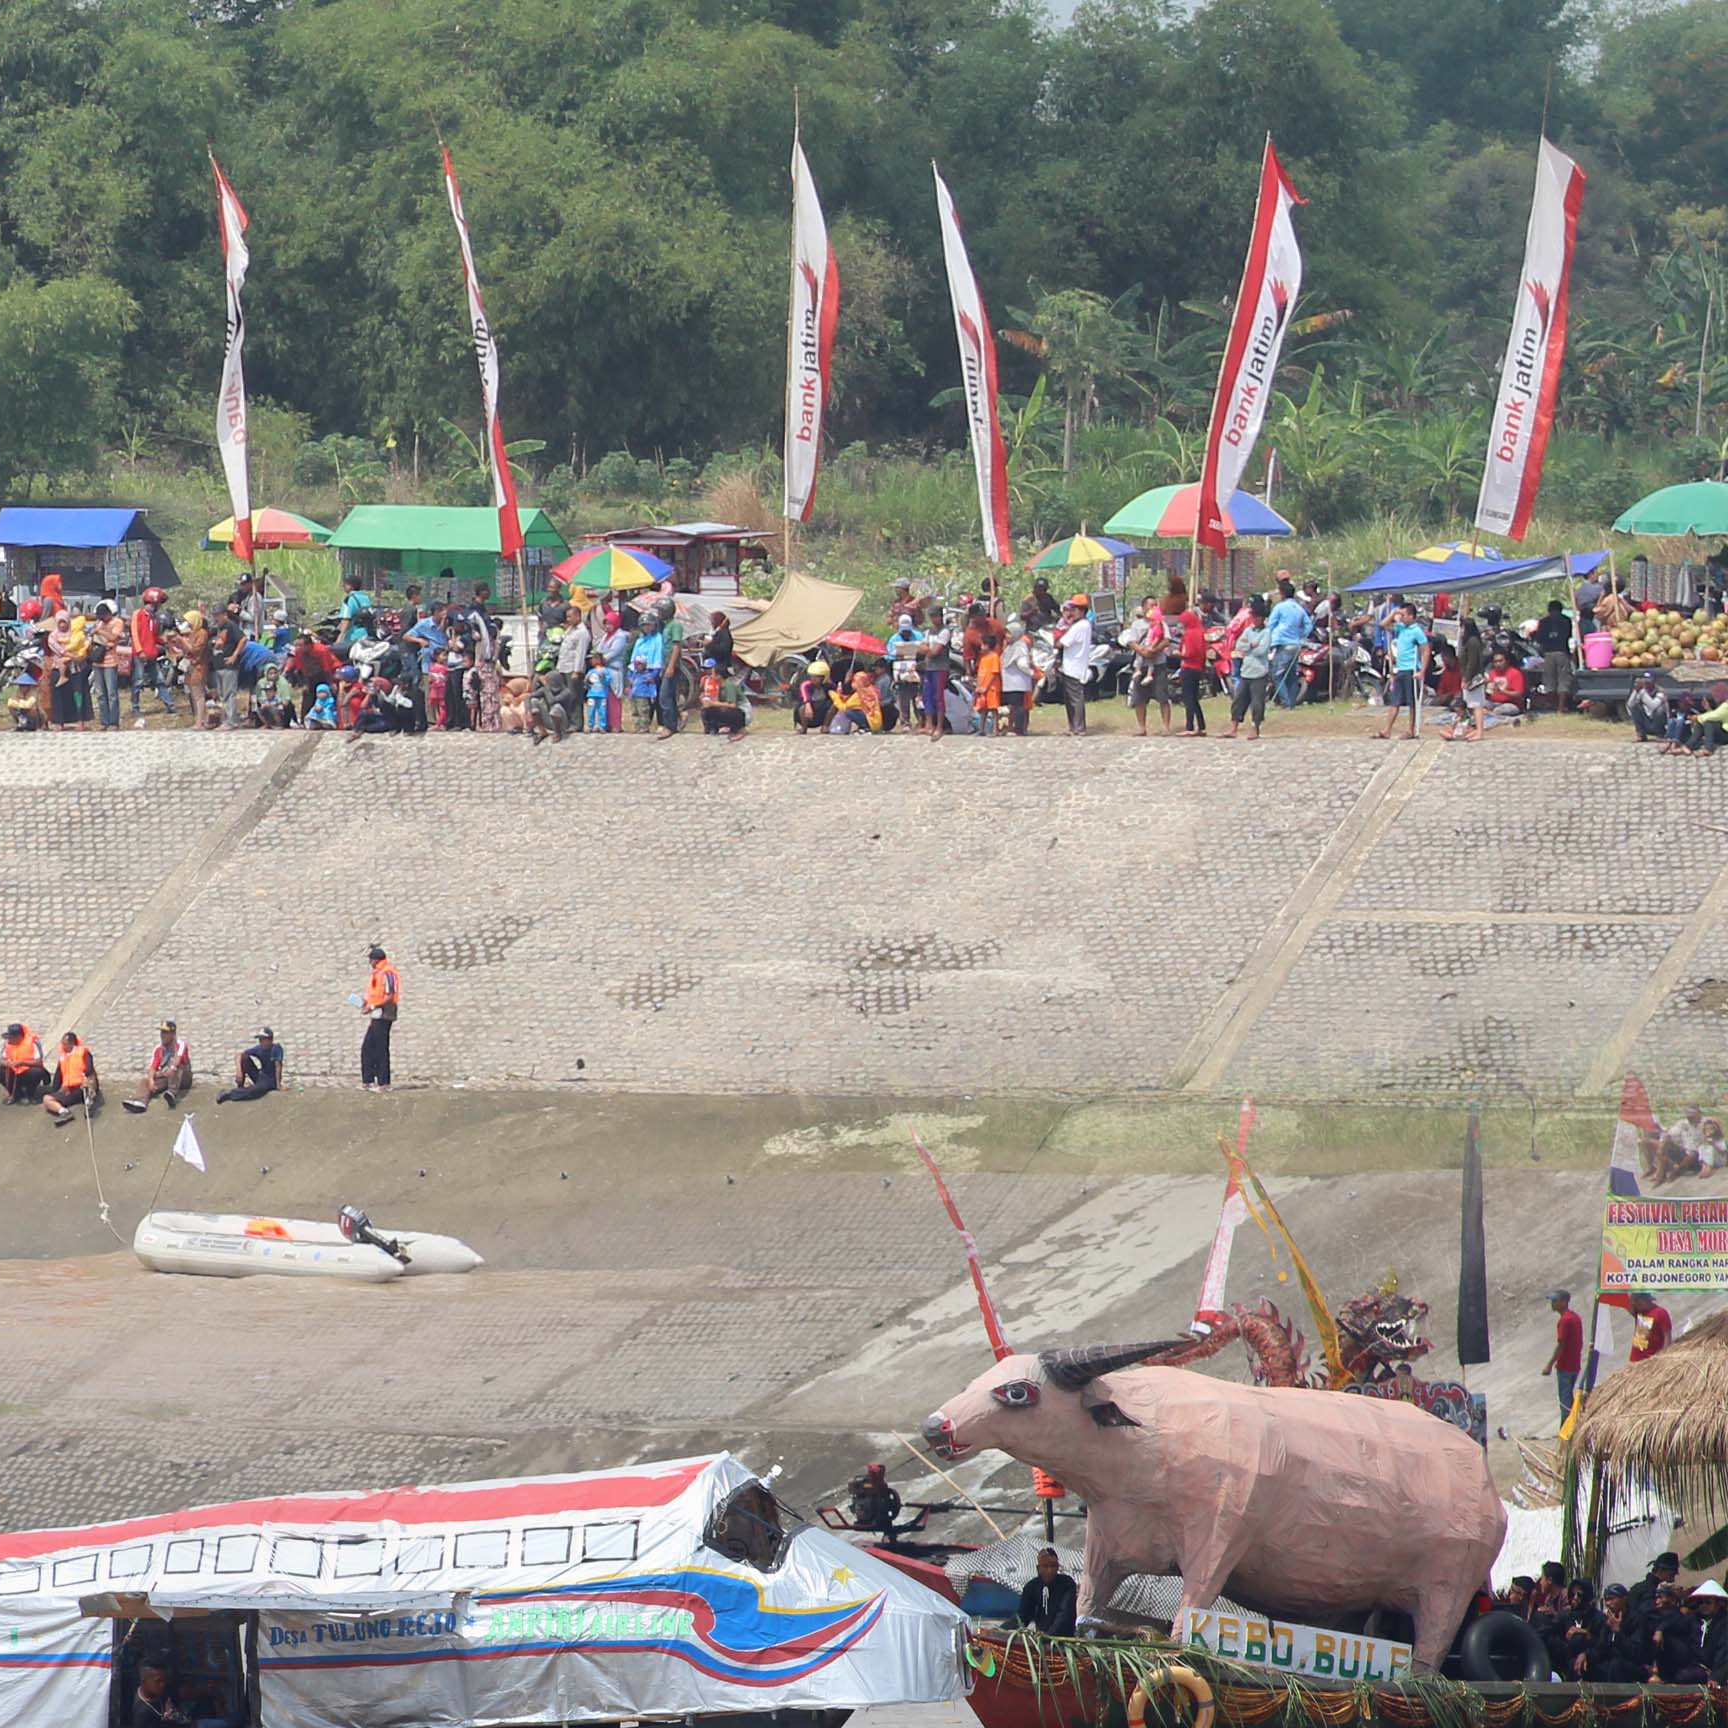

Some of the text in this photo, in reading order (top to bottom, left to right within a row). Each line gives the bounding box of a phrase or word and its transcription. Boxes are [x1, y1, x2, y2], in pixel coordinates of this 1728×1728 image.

[1608, 1202, 1679, 1224] FESTIVAL
[1657, 1230, 1693, 1253] DESA
[1627, 1258, 1665, 1269] DALAM
[1668, 1258, 1709, 1269] RANGKA
[1607, 1273, 1638, 1284] KOTA
[1641, 1272, 1711, 1284] BOJONEGORO
[313, 1619, 391, 1642] TULUNG
